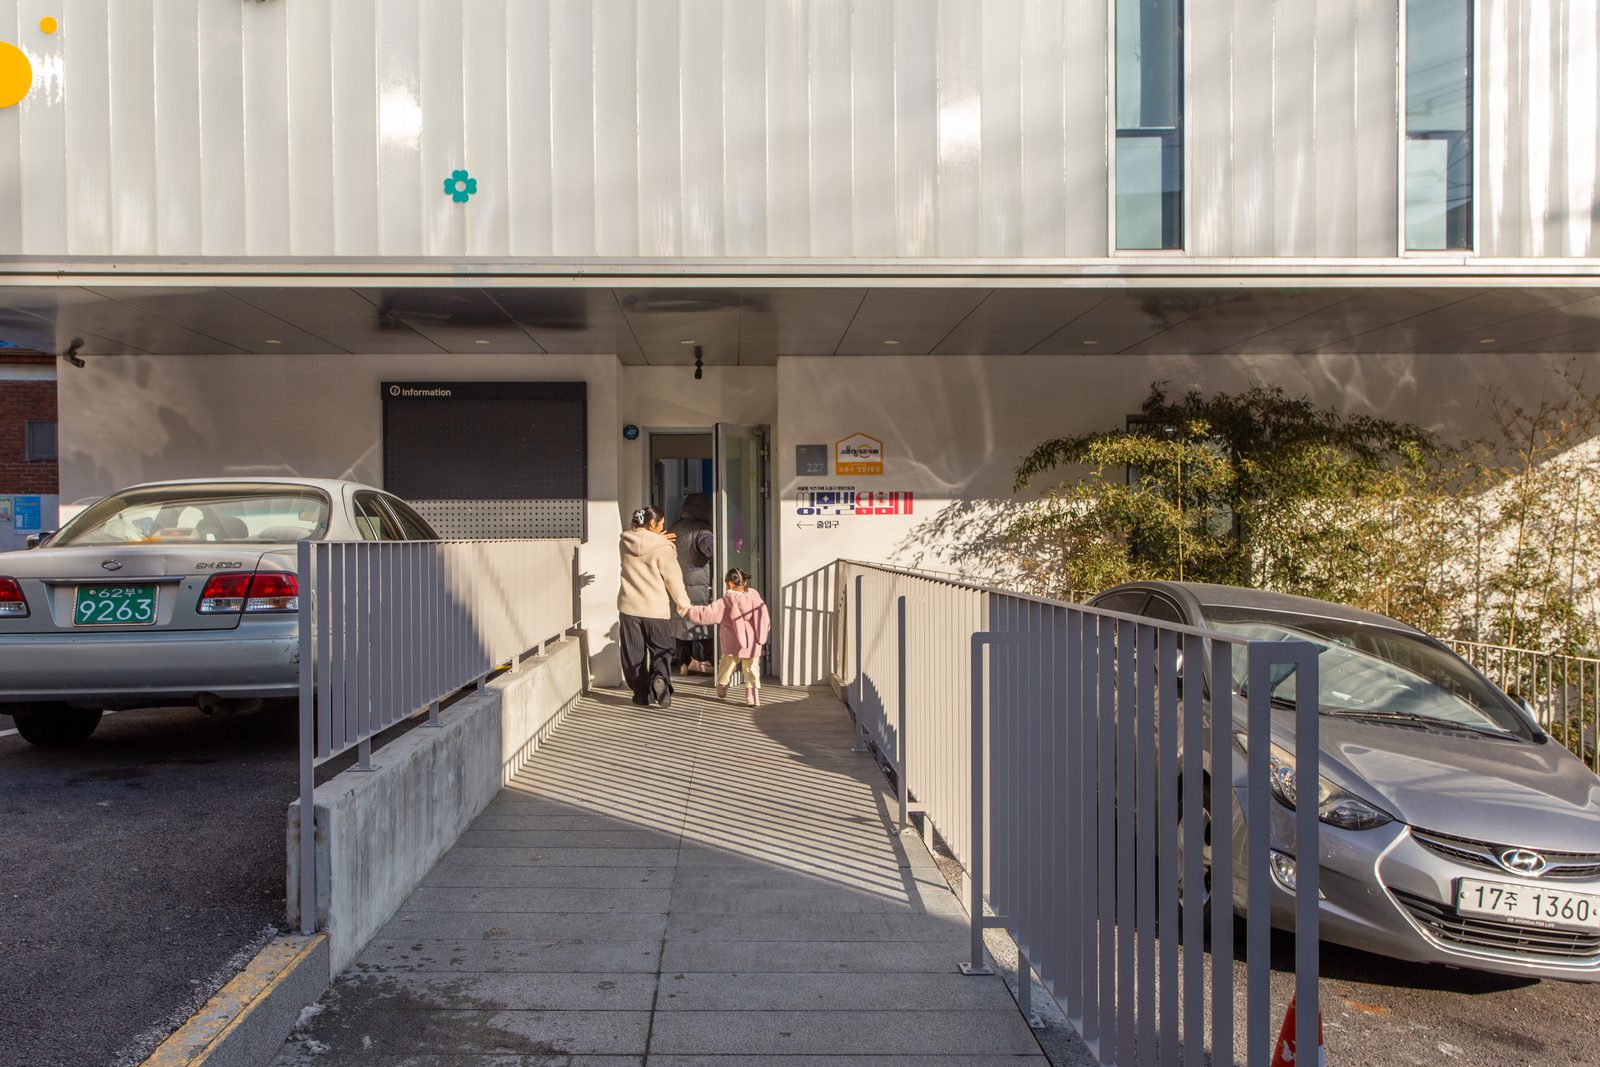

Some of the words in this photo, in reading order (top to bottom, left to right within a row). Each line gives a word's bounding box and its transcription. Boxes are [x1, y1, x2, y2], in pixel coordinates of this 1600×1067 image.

[402, 387, 451, 397] Information
[806, 462, 824, 473] 227
[816, 520, 840, 529] 출입구
[98, 587, 136, 598] 62부
[79, 598, 151, 622] 9263
[1475, 887, 1518, 911] 17주
[1532, 894, 1589, 922] 1360
